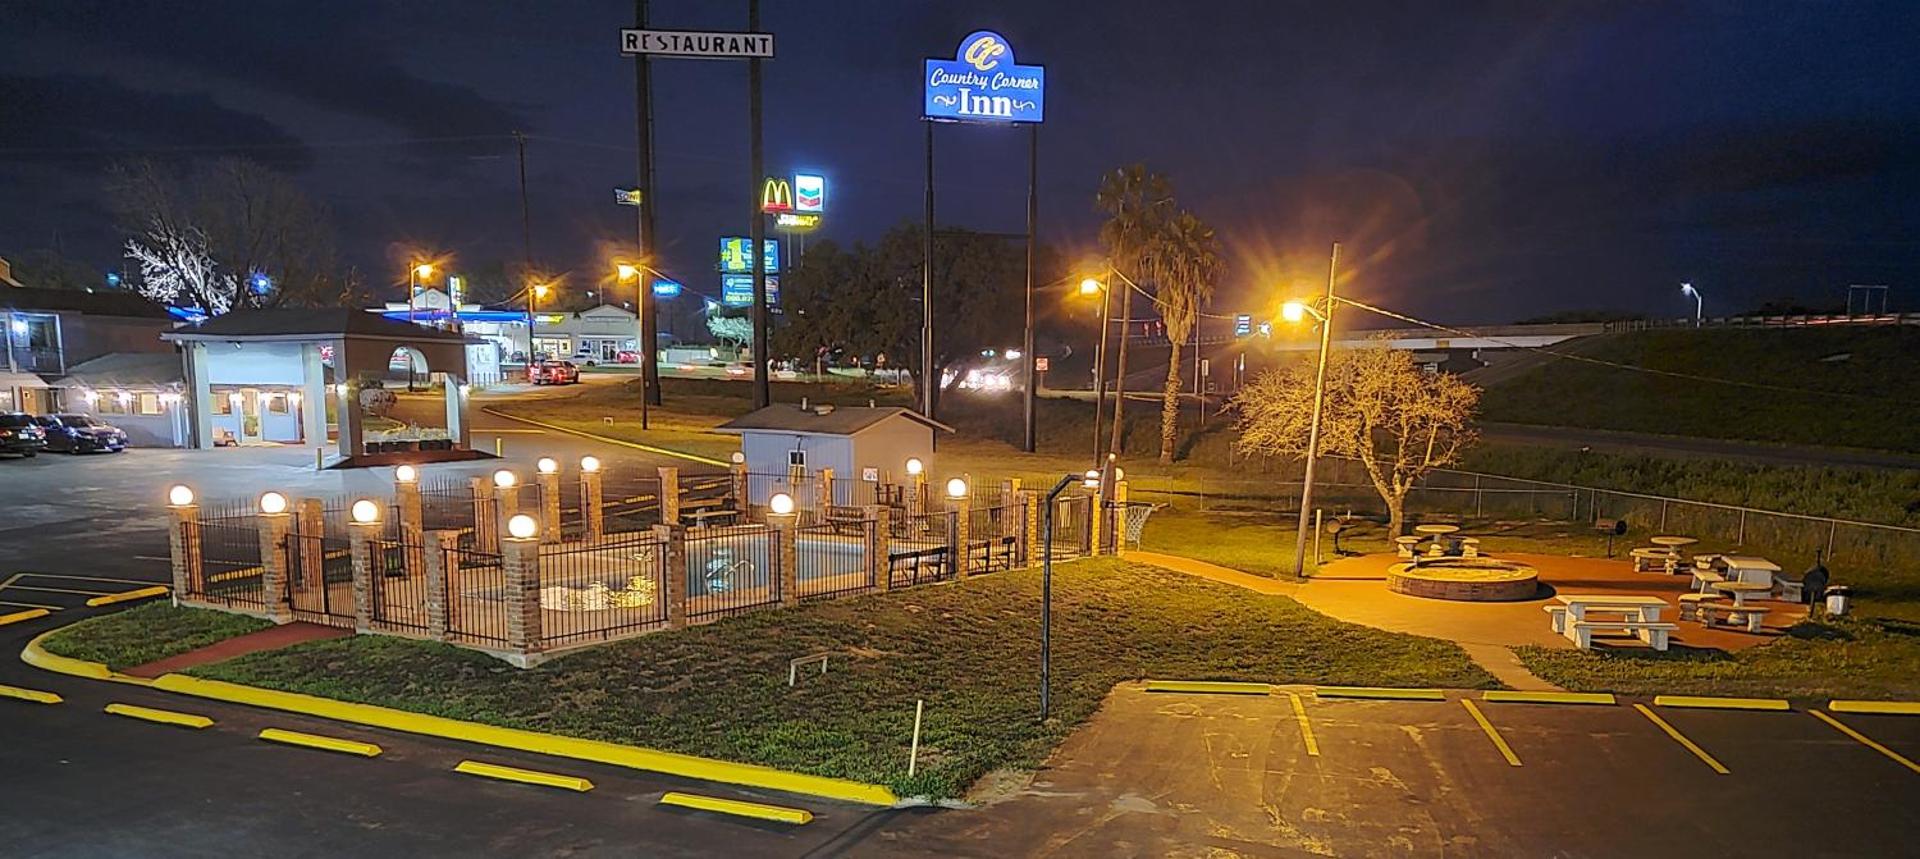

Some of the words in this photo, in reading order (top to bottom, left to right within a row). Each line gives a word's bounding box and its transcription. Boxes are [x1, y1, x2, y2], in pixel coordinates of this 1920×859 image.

[626, 33, 769, 54] RESTAURANT
[930, 68, 989, 90] Country
[991, 72, 1039, 90] Corner
[958, 88, 1013, 117] Inn
